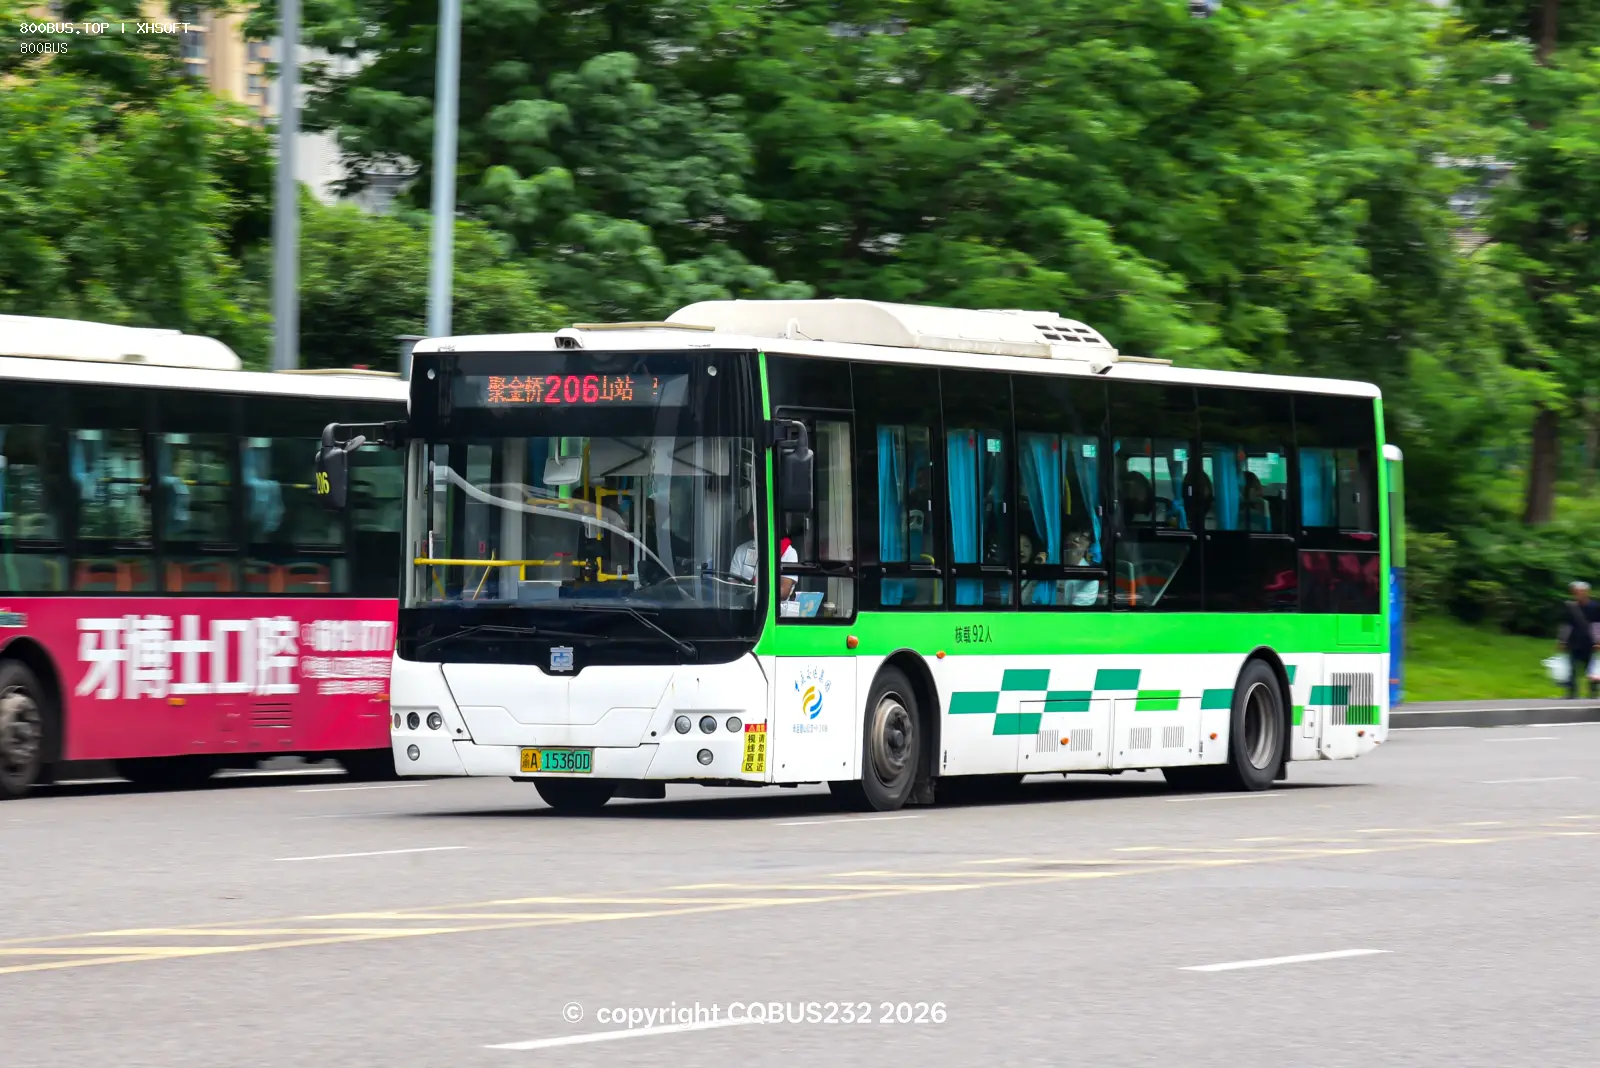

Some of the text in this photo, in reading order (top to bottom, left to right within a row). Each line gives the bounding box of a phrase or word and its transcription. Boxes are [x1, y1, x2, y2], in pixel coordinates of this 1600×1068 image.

[544, 374, 599, 403] 206
[954, 624, 993, 644] 核载92人
[75, 614, 299, 700] 牙博士口腔
